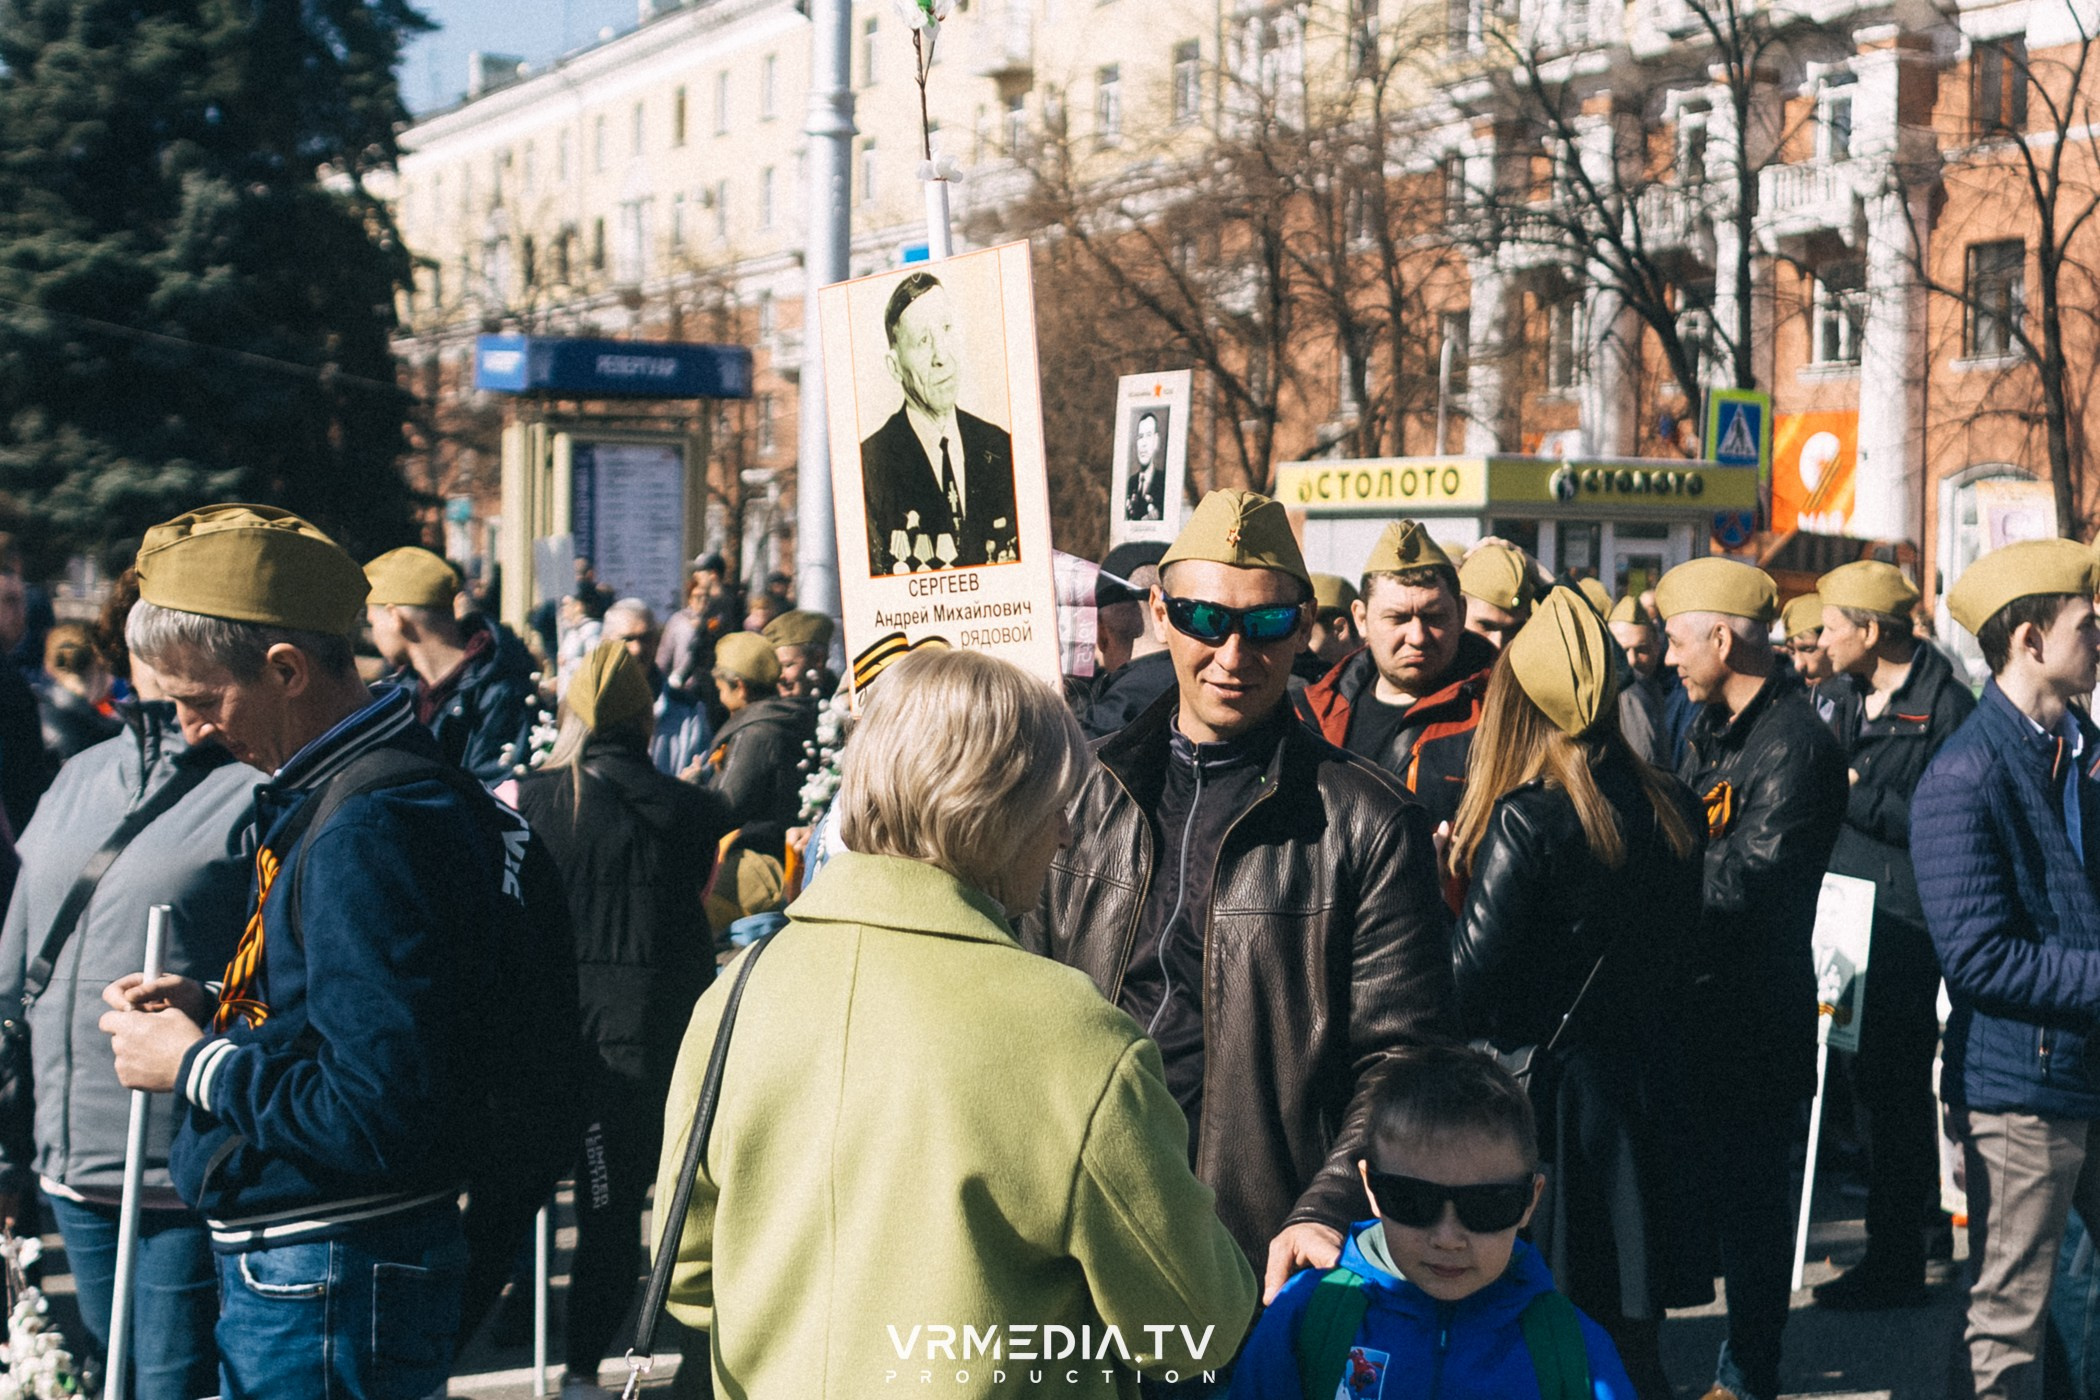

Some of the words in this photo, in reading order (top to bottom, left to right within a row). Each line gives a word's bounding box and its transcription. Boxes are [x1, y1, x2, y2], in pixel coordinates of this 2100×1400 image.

[1317, 467, 1460, 499] СТОЛОТО
[1582, 468, 1704, 495] СТОЛОТО
[908, 573, 980, 597] СЕРГЕЕВ
[875, 606, 928, 629] Андрей
[933, 600, 1032, 623] Михайлович
[585, 1136, 601, 1209] EDITION
[594, 1134, 609, 1206] LIMITED
